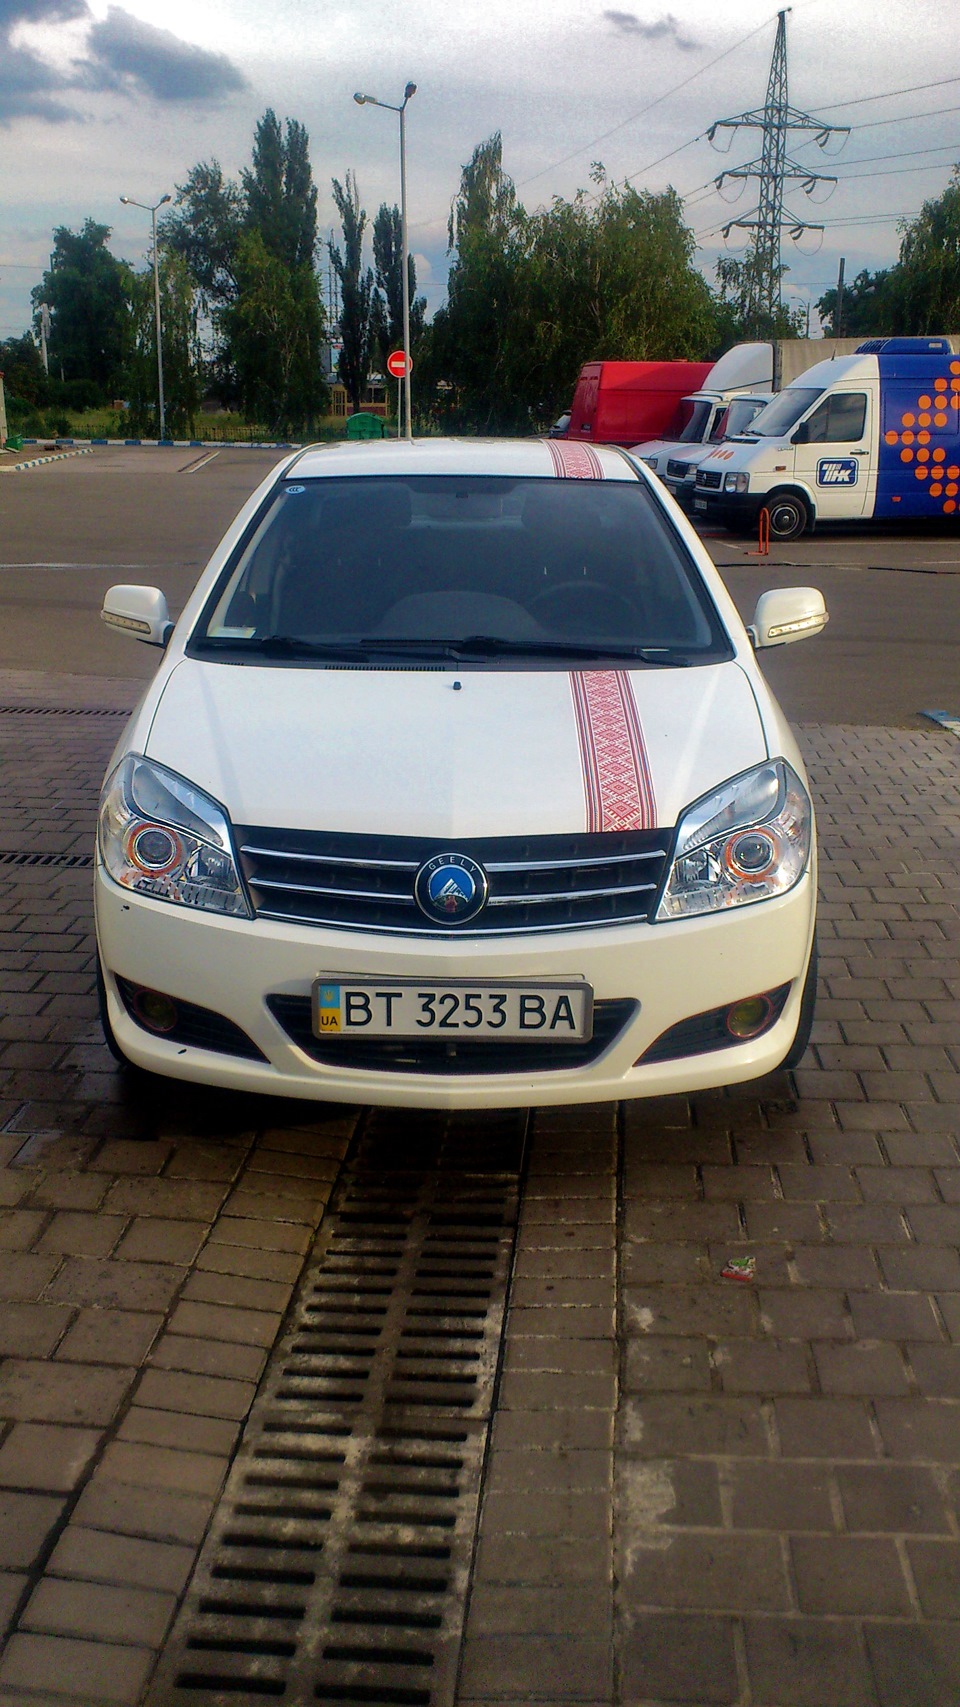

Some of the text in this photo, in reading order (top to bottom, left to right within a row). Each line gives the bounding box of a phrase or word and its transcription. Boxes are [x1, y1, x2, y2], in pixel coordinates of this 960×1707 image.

[428, 856, 477, 872] GEELY
[345, 991, 576, 1030] BT 3253 BA
[321, 1016, 338, 1026] UA
